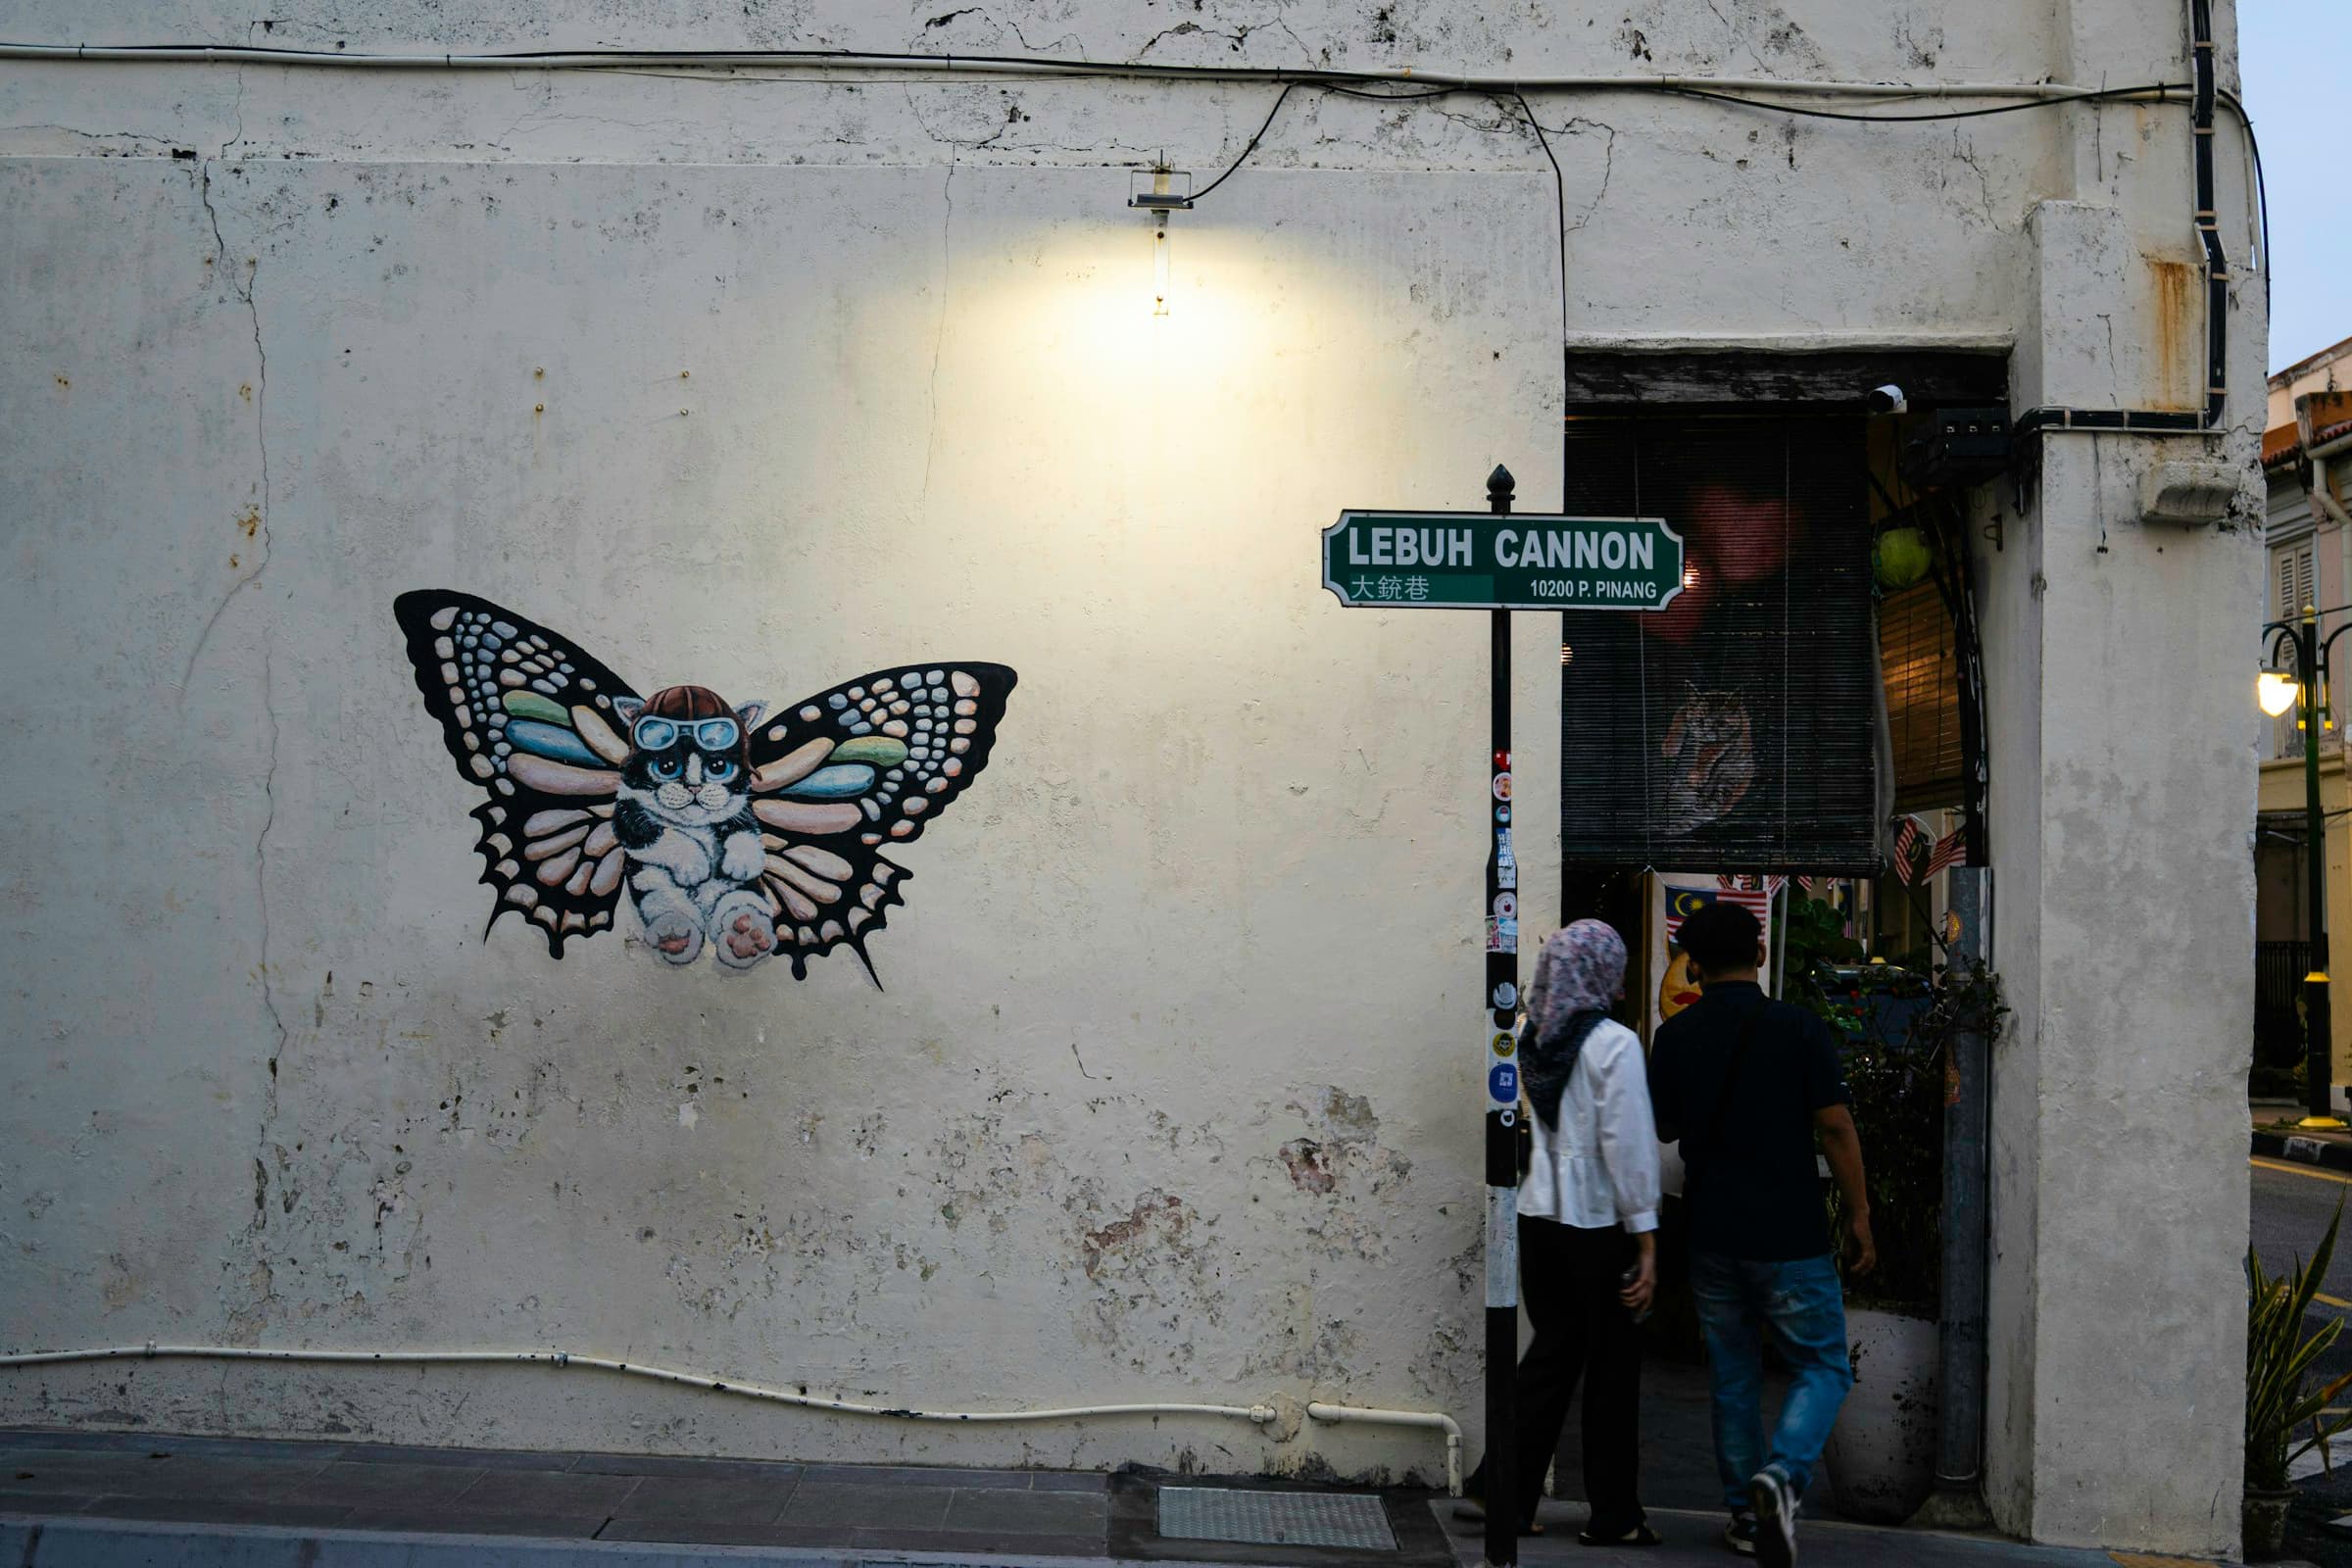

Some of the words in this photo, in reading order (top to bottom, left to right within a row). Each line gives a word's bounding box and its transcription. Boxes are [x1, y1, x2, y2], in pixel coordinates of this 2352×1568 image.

[1348, 526, 1473, 567] LEBUH
[1494, 528, 1654, 570] CANNON
[1349, 574, 1430, 601] 大銃巷
[1530, 579, 1574, 598] 10200
[1579, 580, 1592, 598] P.
[1595, 580, 1657, 599] PINANG
